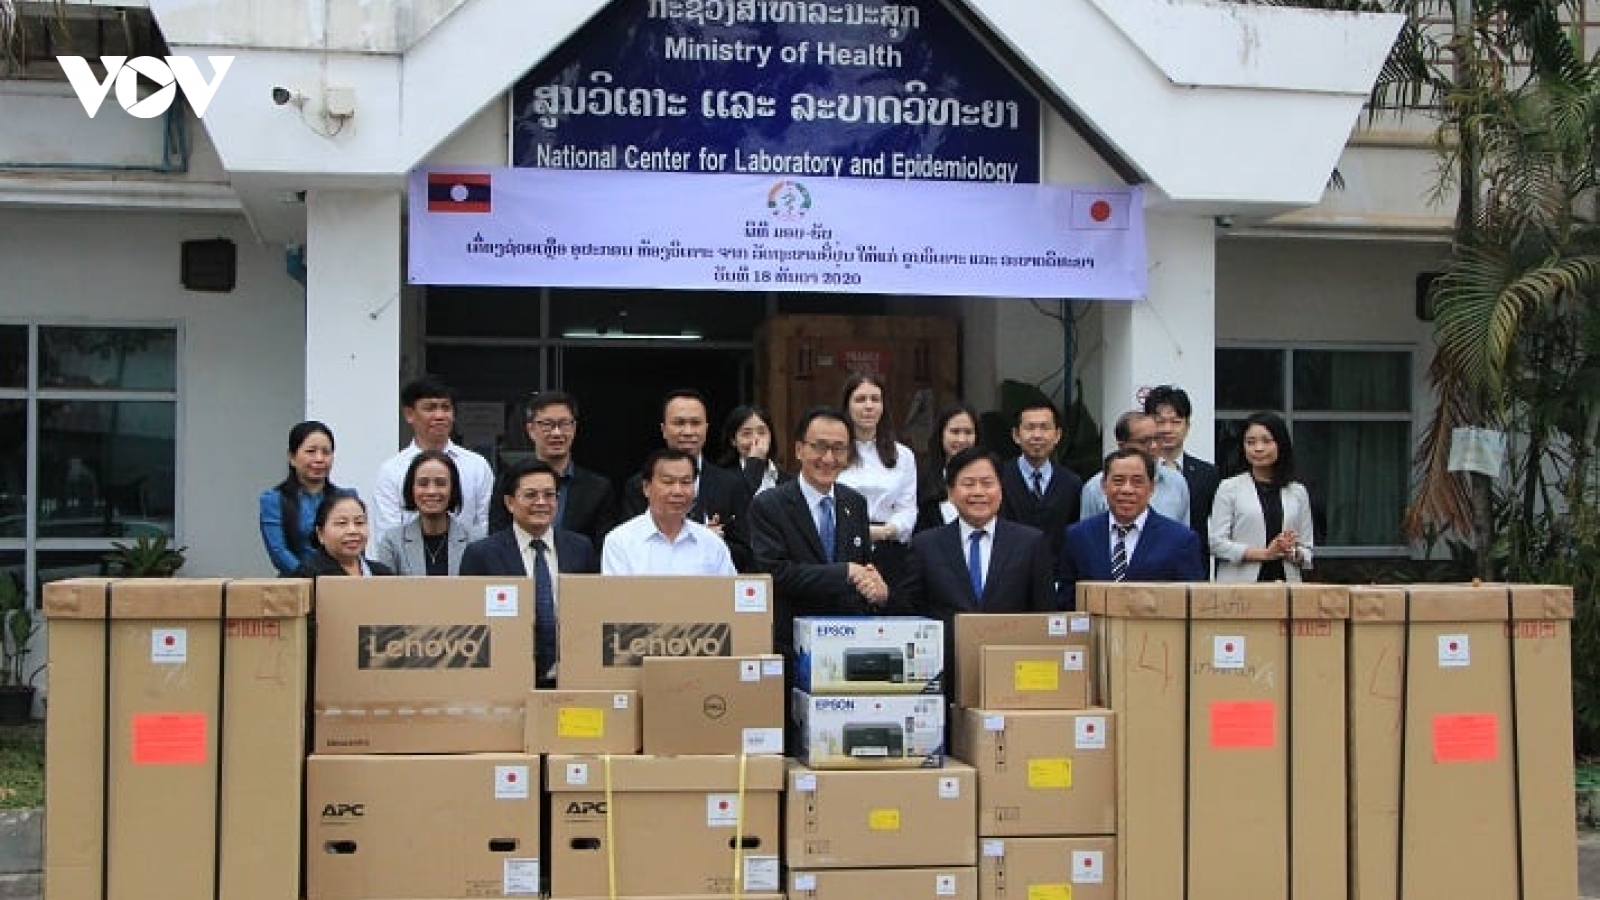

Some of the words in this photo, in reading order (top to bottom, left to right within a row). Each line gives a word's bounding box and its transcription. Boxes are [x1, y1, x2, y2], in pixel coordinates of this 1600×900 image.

[664, 36, 772, 68] Ministry
[780, 42, 809, 64] of
[817, 42, 902, 68] Health
[534, 70, 688, 128] ສູນວິເຄາະ
[703, 89, 776, 119] ແລະ
[790, 80, 1019, 129] ລະບາດວິທະຍາ
[537, 143, 617, 169] National
[624, 145, 690, 171] Center
[699, 147, 727, 171] for
[734, 148, 843, 179] Laboratory
[850, 152, 885, 176] and
[891, 153, 1019, 184] Epidemiology
[754, 270, 771, 283] 18
[822, 271, 861, 285] 2020
[817, 625, 855, 636] EPSON
[369, 634, 479, 658] Lenovo
[613, 633, 721, 657] Lenovo
[815, 700, 855, 711] EPSON
[322, 803, 364, 816] APC
[566, 801, 608, 814] APC
